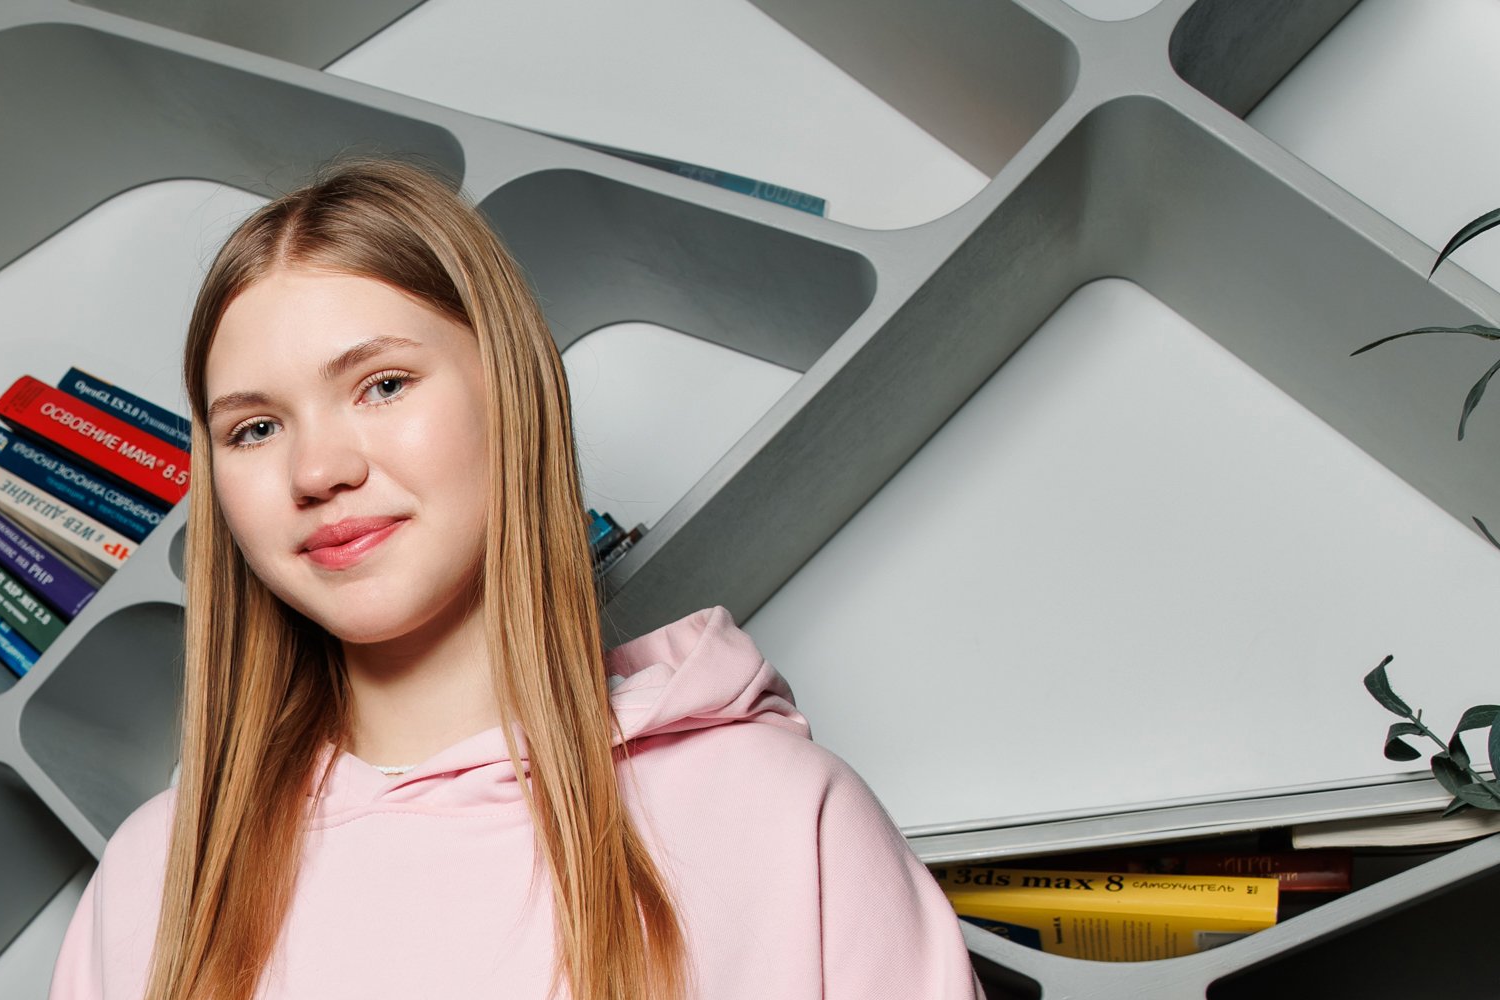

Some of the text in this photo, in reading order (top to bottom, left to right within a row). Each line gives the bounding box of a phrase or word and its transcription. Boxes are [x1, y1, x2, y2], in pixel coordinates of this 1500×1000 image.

[72, 378, 111, 406] OpenGL
[109, 396, 126, 411] ES
[38, 399, 120, 450] ОСВОЕНИЕ
[161, 462, 189, 486] 8.5
[54, 462, 106, 497] ЭКОНОМИКА
[14, 554, 29, 570] на
[27, 563, 54, 586] PHP
[1, 579, 39, 612] ASP.NET
[32, 606, 52, 625] 2.0
[953, 867, 1125, 893] 3ds max 8
[1132, 881, 1236, 894] САМОУЧИТЕЛЬ
